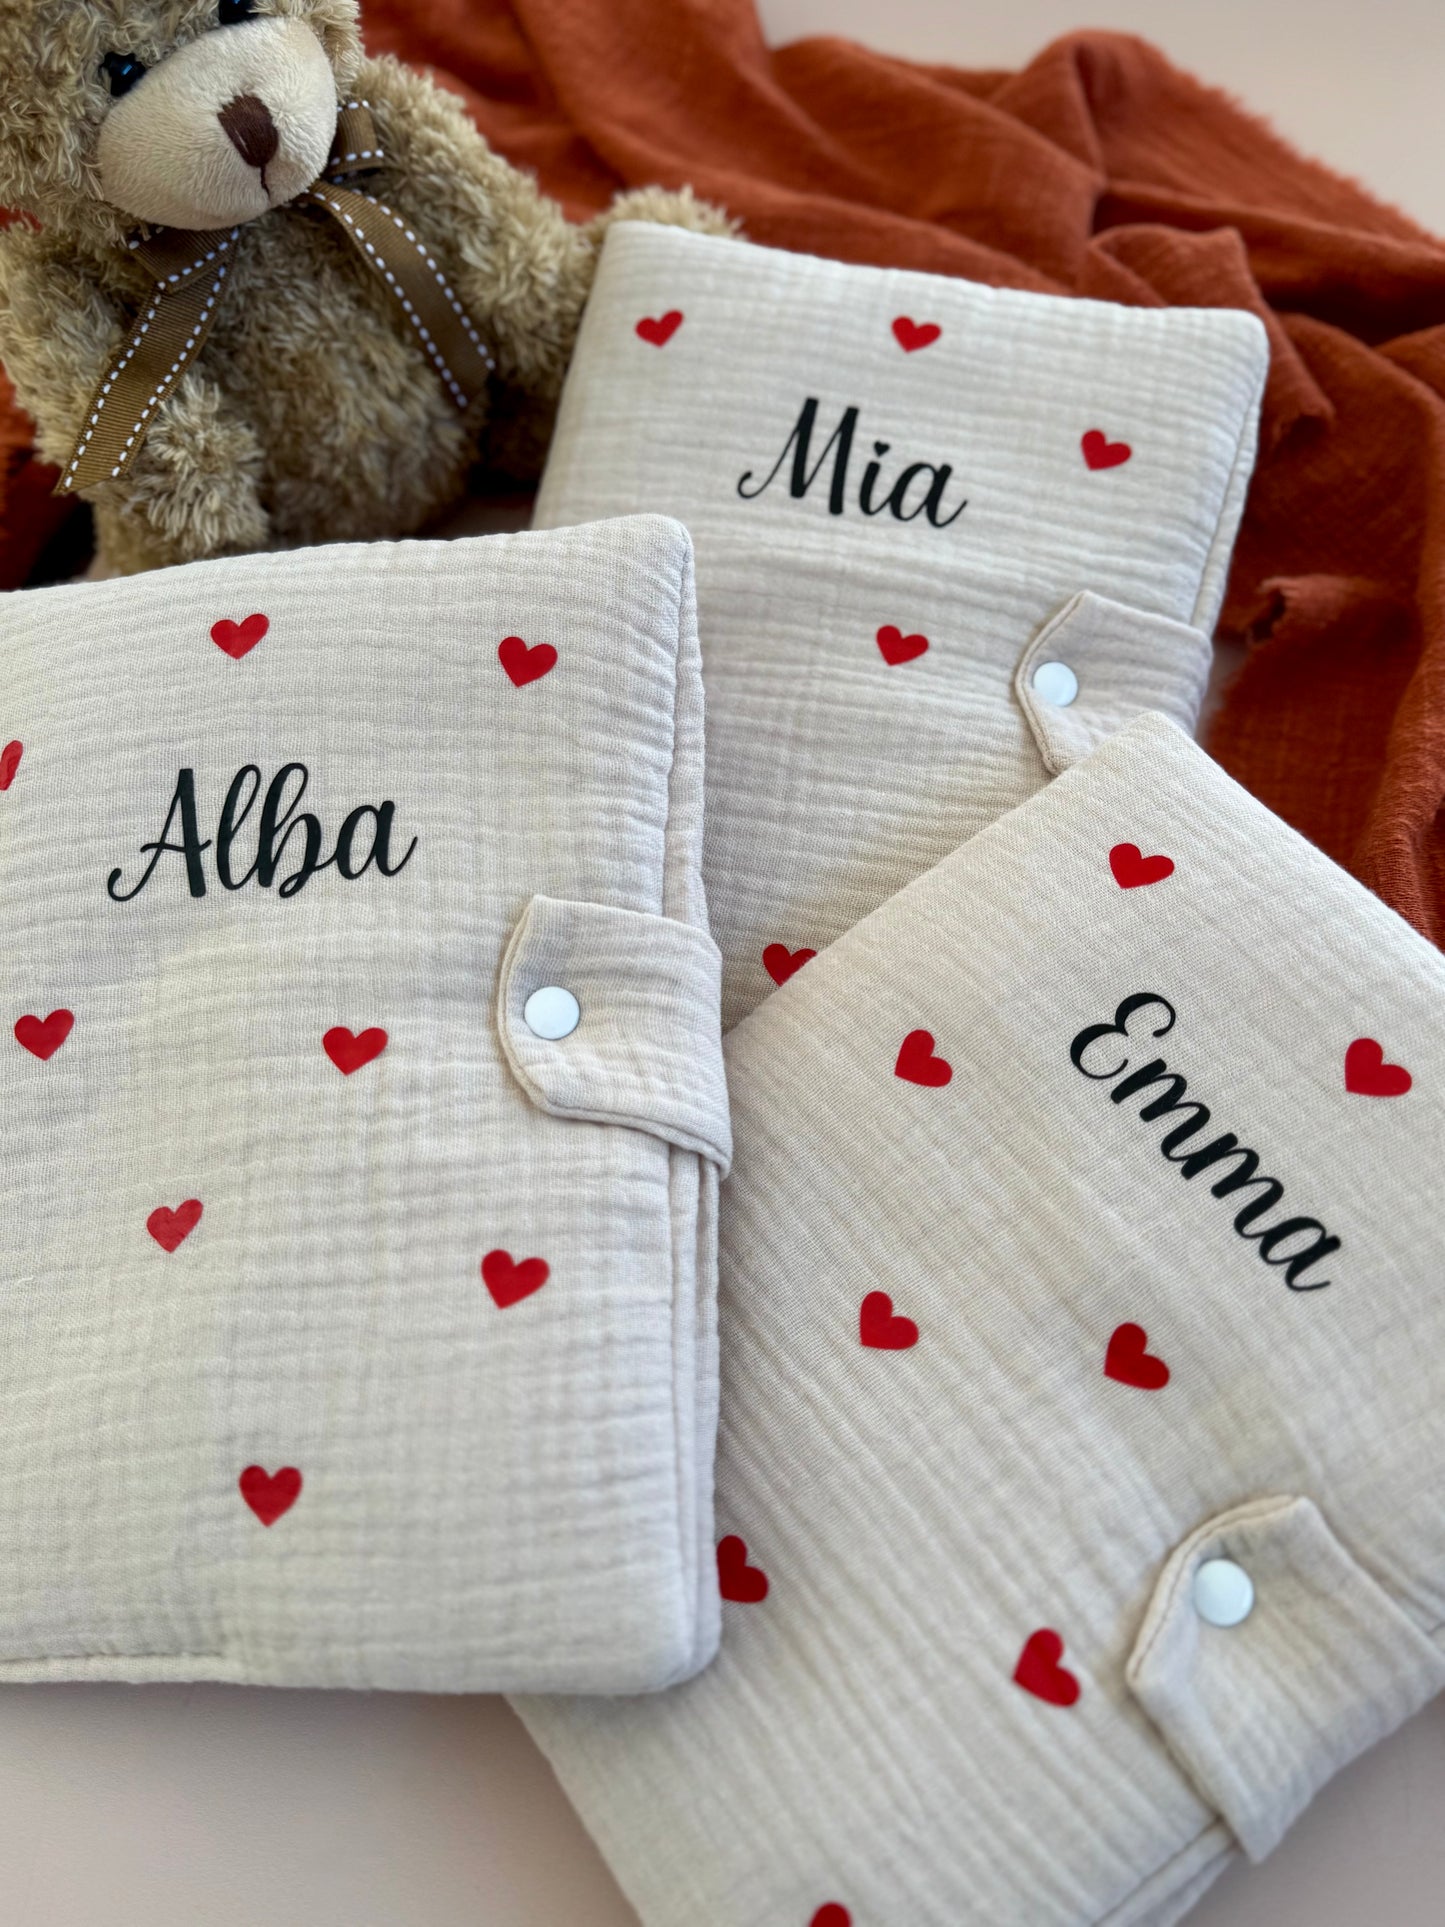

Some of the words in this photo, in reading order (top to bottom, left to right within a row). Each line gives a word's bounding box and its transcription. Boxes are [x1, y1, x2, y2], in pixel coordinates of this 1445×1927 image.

[737, 397, 968, 528] Mia
[108, 762, 418, 902] Alba
[1070, 991, 1348, 1293] Emma
